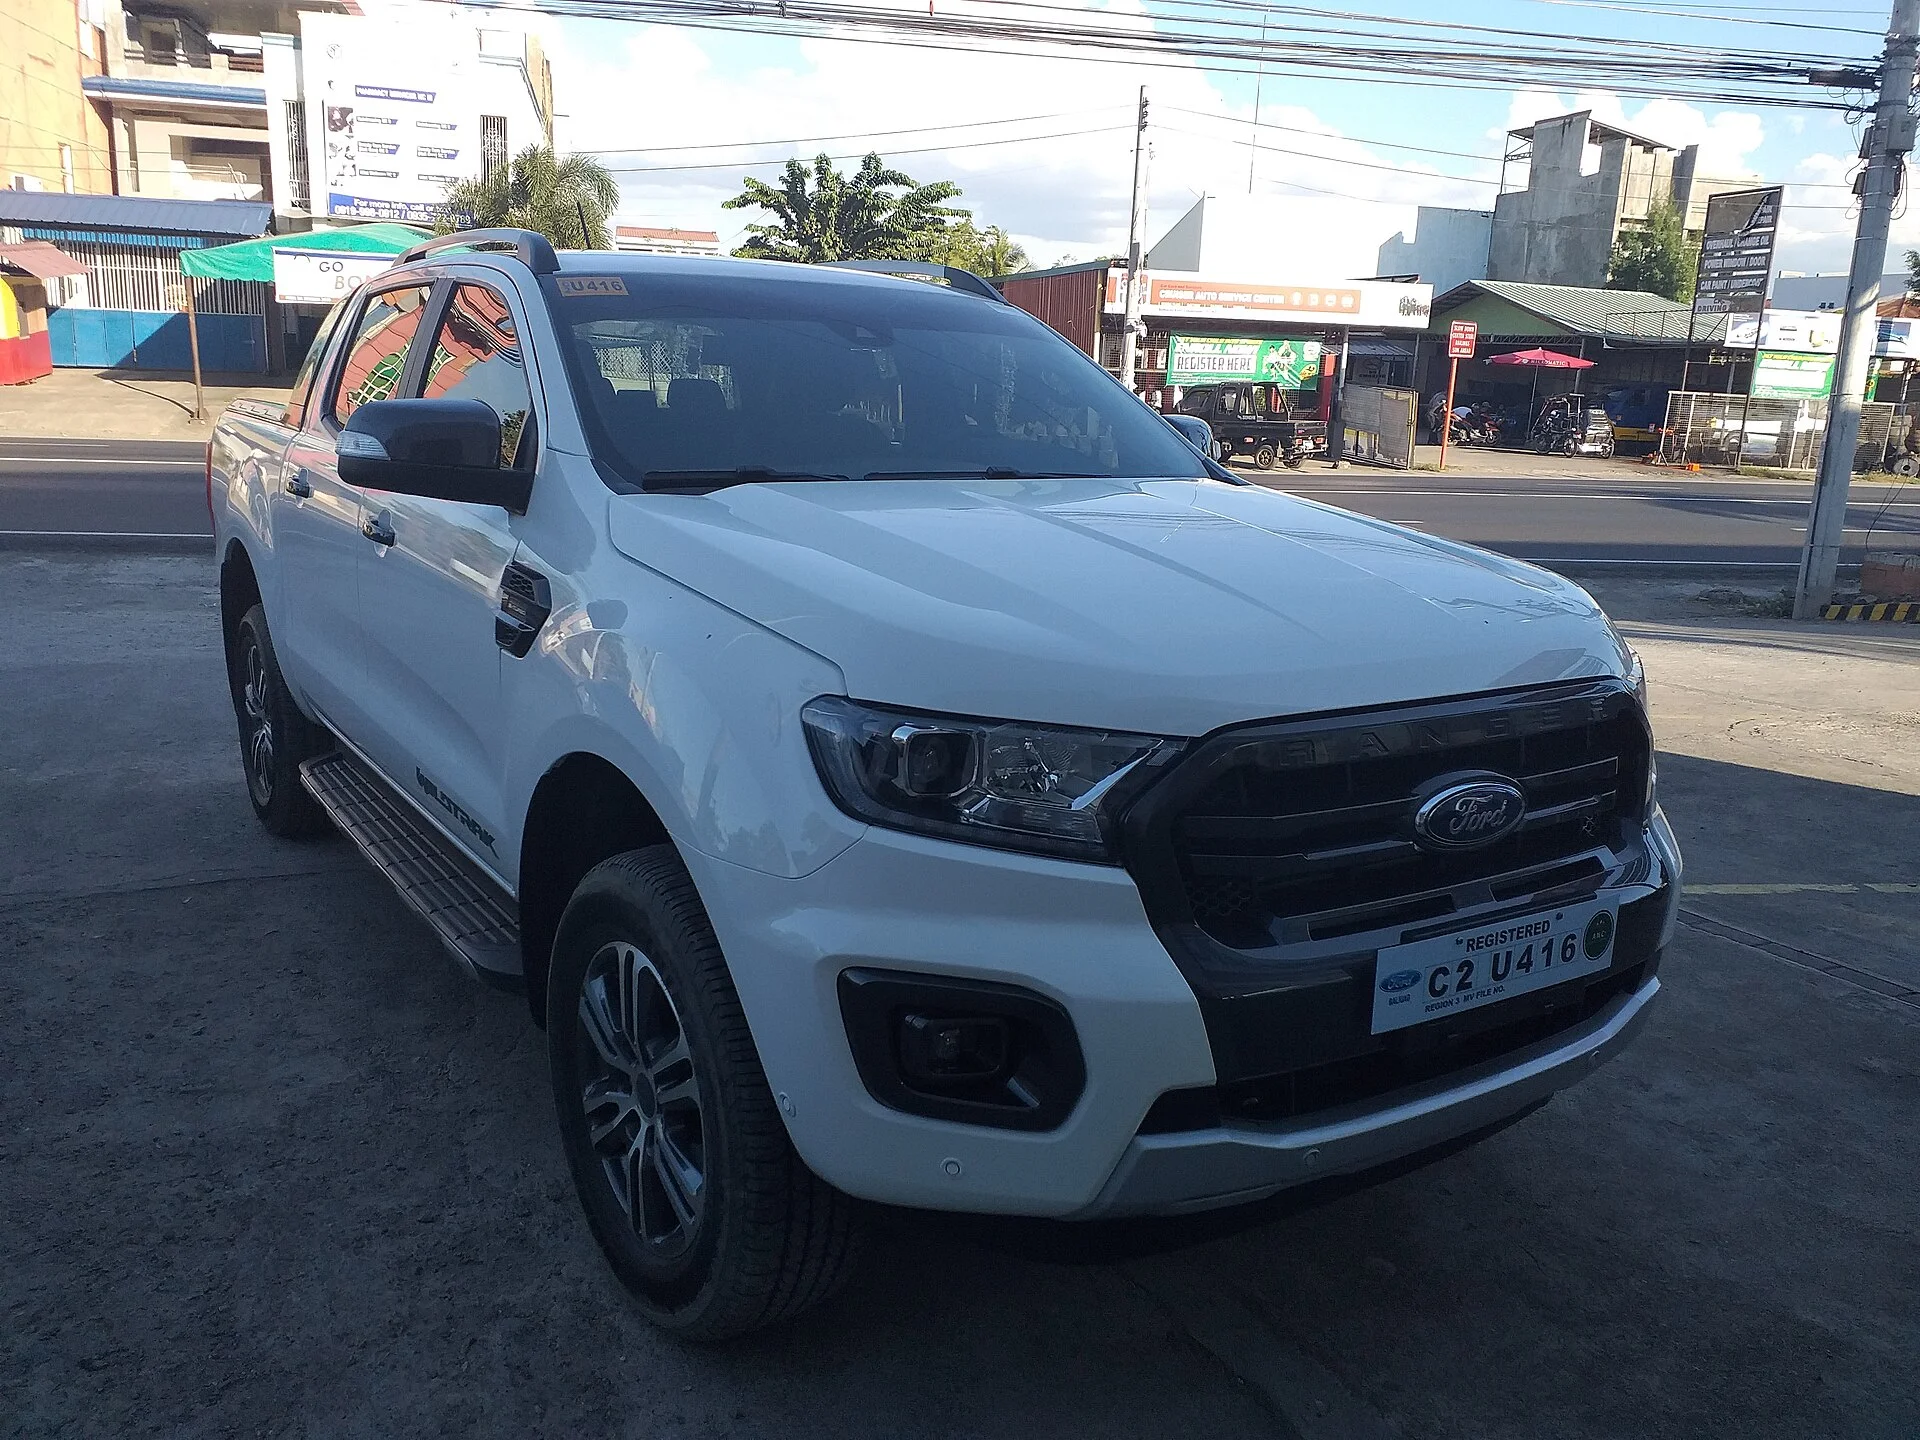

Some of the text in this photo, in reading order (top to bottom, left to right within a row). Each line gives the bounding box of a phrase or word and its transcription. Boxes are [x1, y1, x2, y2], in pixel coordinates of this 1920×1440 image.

[353, 198, 367, 208] For
[369, 200, 391, 209] more
[410, 203, 424, 212] call
[1706, 239, 1734, 250] OVERHAUL
[1760, 235, 1770, 246] OIL
[319, 261, 344, 273] GO
[1704, 258, 1723, 269] POWER
[1723, 257, 1746, 268] WINDOW
[1749, 256, 1766, 267] DOOR
[570, 281, 623, 291] U416
[1701, 280, 1711, 291] CAR
[1711, 279, 1727, 290] PAINT
[1195, 290, 1217, 301] AUTO
[1218, 292, 1252, 302] SERVICE
[1177, 356, 1252, 370] REGISTER HERE
[1279, 697, 1608, 767] RANGER
[1450, 794, 1507, 835] Ford
[1466, 919, 1551, 952] REGISTERED
[1428, 933, 1577, 999] C2 U416
[1424, 999, 1454, 1013] REGION
[1463, 993, 1475, 1003] MV
[1476, 988, 1491, 999] FILE
[1493, 985, 1506, 996] NO.
